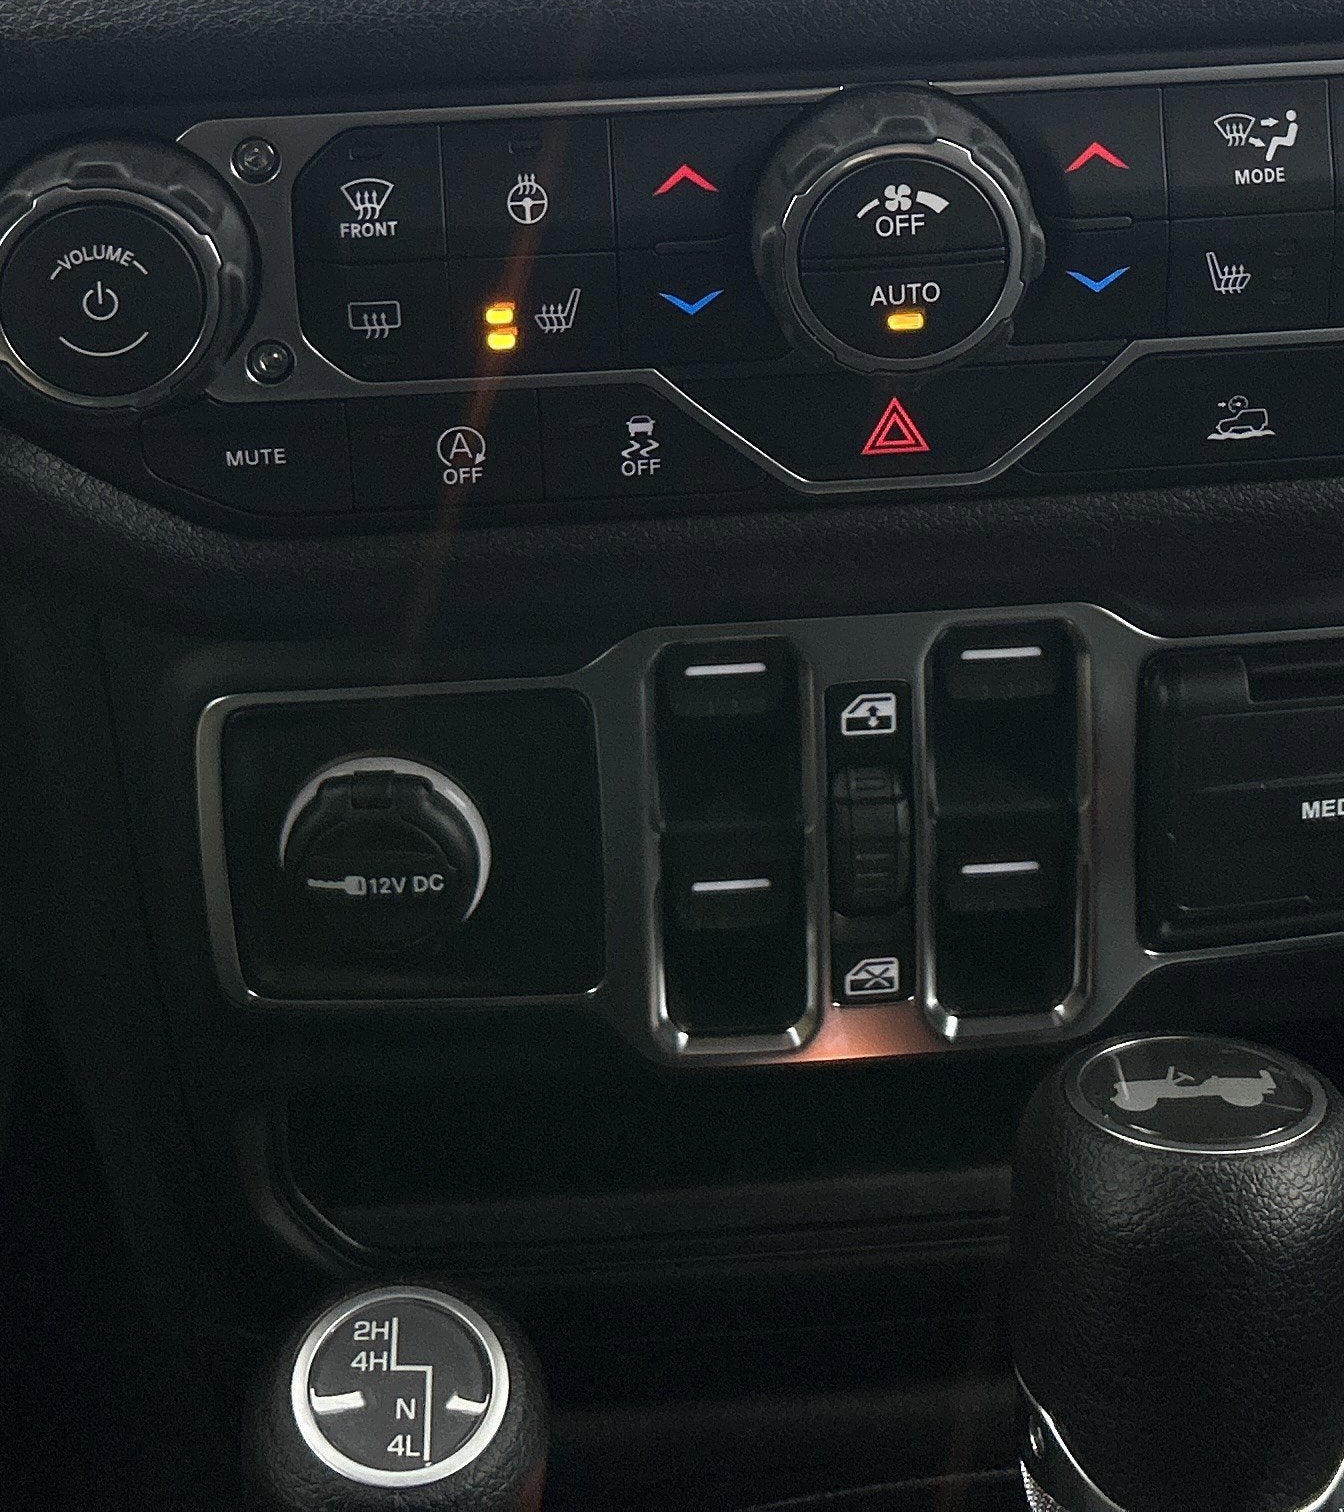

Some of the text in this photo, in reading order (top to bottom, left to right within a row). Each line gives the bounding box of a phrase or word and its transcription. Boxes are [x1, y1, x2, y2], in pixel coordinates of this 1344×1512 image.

[1234, 166, 1286, 185] MODE
[339, 220, 398, 238] FRONT
[875, 213, 925, 237] OFF
[57, 244, 133, 270] VOLUME
[870, 281, 941, 310] AUTO
[225, 448, 287, 467] MUTE
[620, 454, 661, 477] OFF
[442, 464, 483, 485] OFF
[364, 873, 445, 895] 12V DC
[353, 1320, 390, 1341] 2H
[350, 1350, 388, 1372] 4H
[395, 1397, 416, 1420] N
[386, 1434, 421, 1457] 4L
